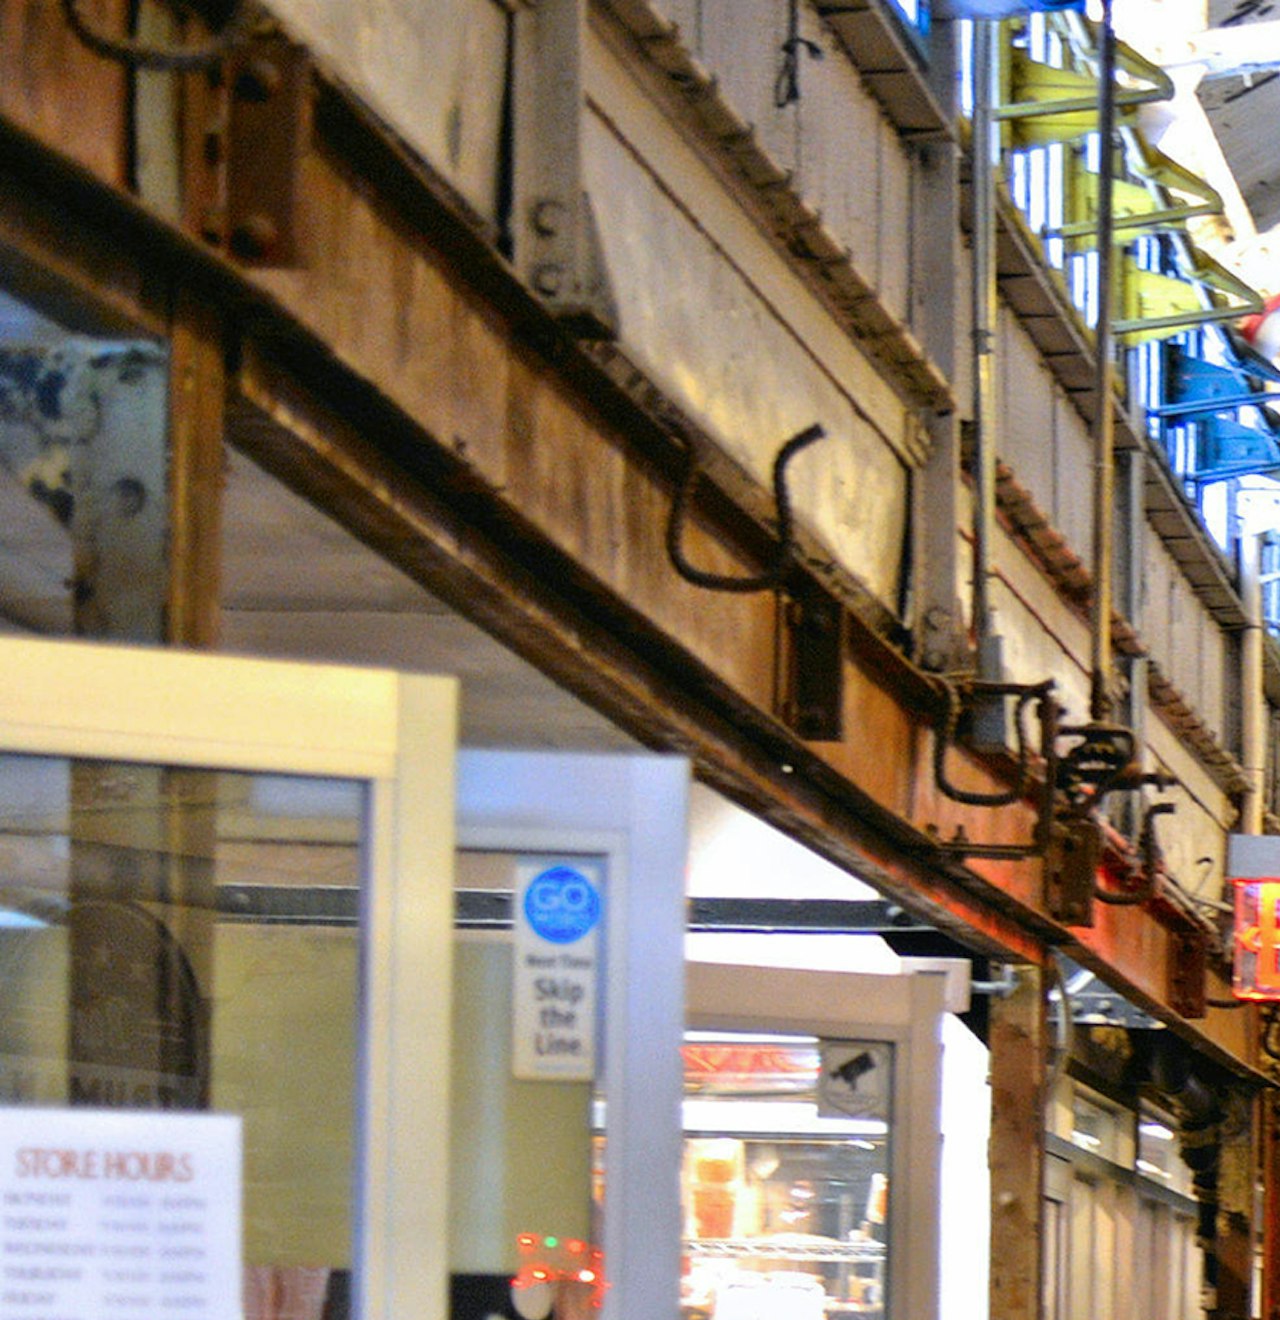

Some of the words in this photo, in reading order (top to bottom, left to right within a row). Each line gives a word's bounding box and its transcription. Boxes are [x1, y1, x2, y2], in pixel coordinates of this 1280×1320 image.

[533, 882, 589, 911] GO
[534, 979, 584, 1004] Skip
[540, 1007, 576, 1027] the
[534, 1033, 581, 1056] Line
[16, 1149, 98, 1179] STORE
[104, 1152, 194, 1183] HOURS
